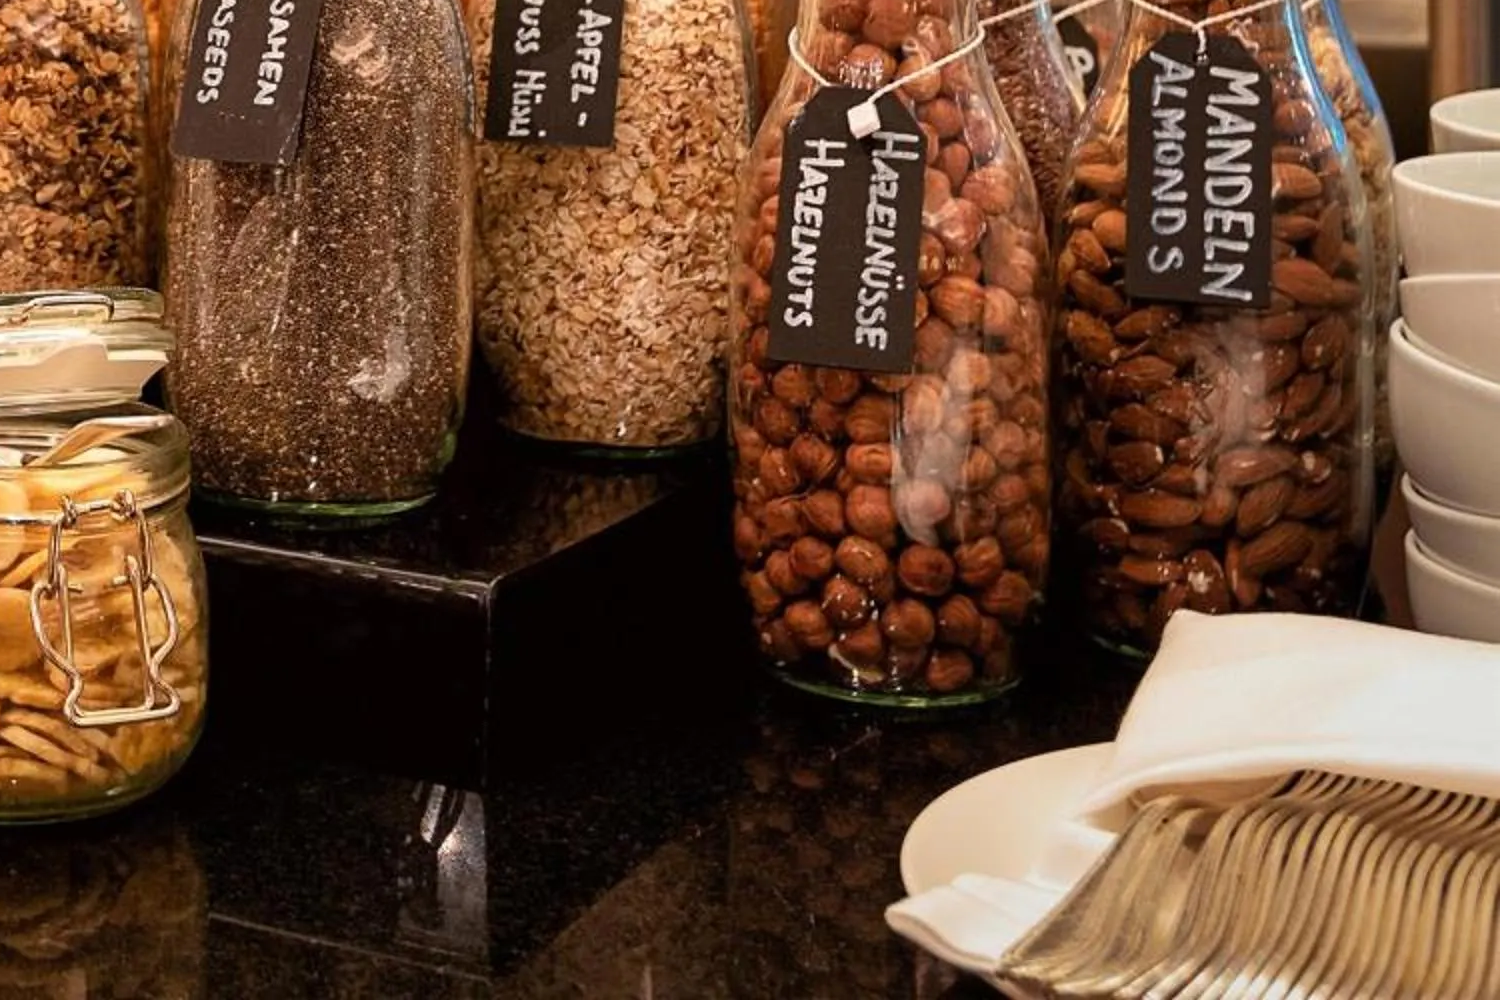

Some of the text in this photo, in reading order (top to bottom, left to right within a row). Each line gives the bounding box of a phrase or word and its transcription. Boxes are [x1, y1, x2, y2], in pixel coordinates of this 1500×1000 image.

[783, 138, 848, 328] HAZELNUTS
[854, 130, 920, 351] HAZELNÜSSE
[1200, 65, 1261, 301] MANDELN
